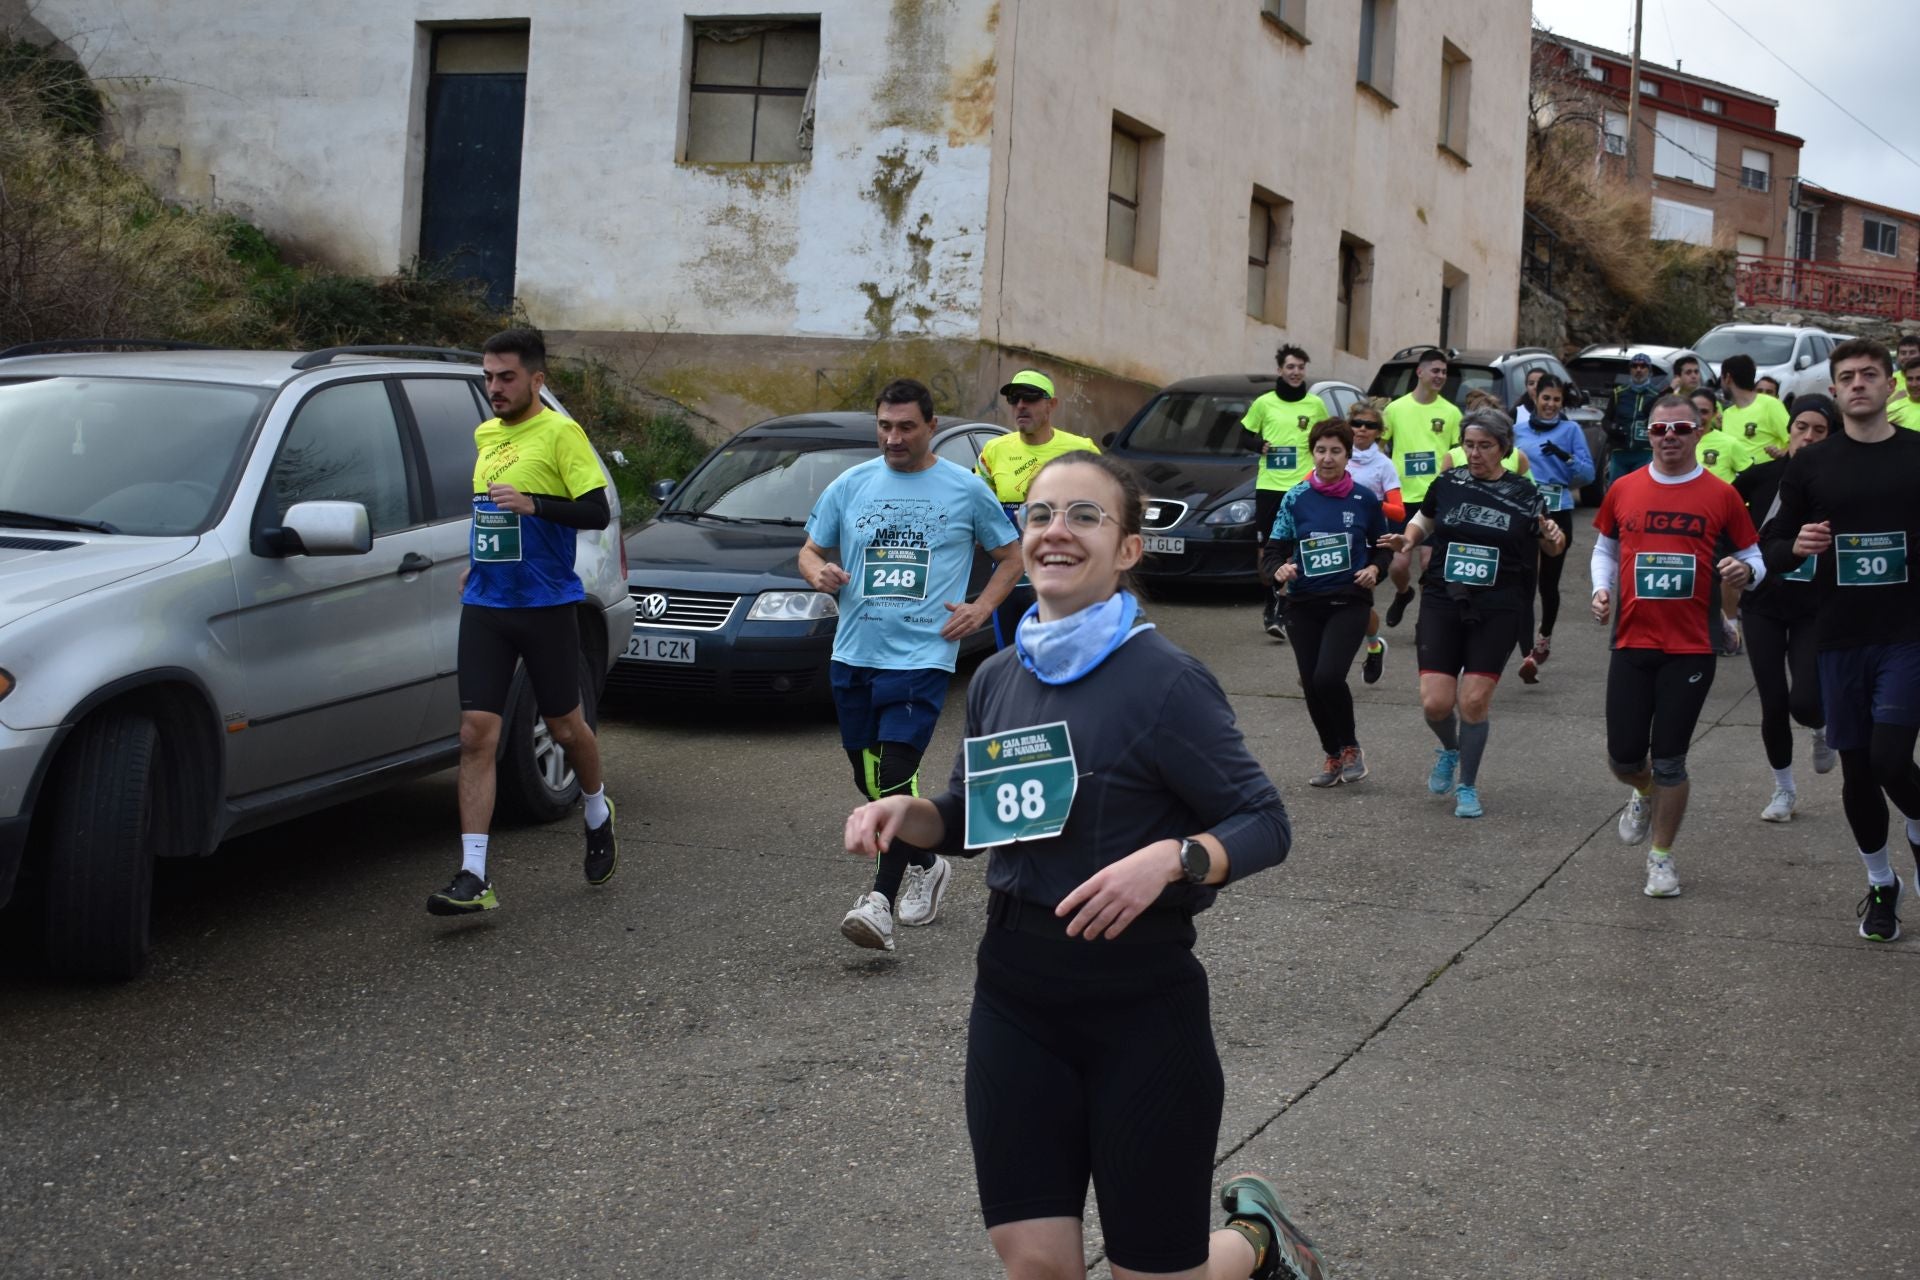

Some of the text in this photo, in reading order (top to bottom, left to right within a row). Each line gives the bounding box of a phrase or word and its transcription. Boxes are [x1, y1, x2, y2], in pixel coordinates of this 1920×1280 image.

[487, 456, 520, 483] TLETISMO
[1274, 456, 1288, 467] 11
[1412, 462, 1428, 472] 10
[477, 533, 500, 552] 51
[875, 528, 924, 541] Marcha
[1157, 538, 1182, 552] GLC
[1310, 551, 1343, 569] 285
[1856, 556, 1888, 576] 30
[872, 568, 916, 588] 248
[1453, 561, 1489, 579] 296
[1644, 573, 1682, 591] 141
[657, 641, 691, 661] CZK
[996, 779, 1046, 823] 88
